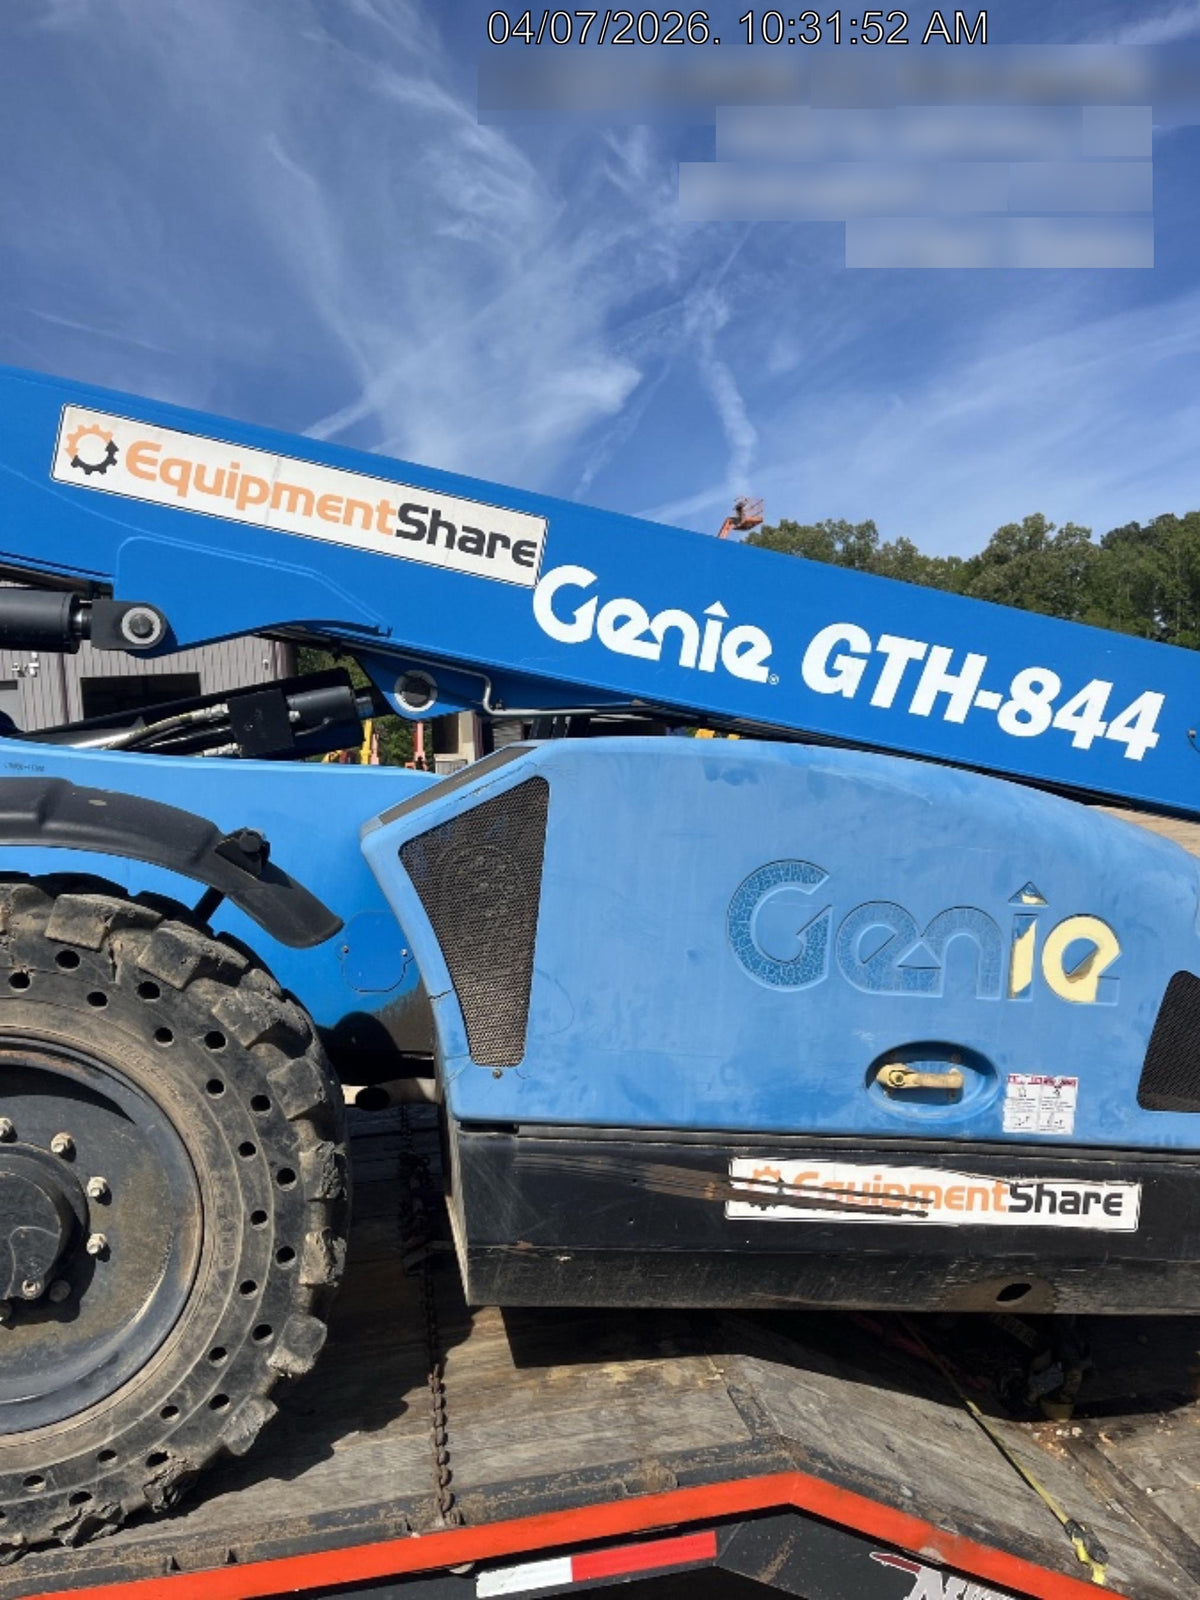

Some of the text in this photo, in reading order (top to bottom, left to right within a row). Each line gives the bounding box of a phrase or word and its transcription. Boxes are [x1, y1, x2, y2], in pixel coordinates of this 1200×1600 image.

[126, 440, 537, 568] EquipmentShare
[533, 565, 1165, 761] Genie GTH-844
[727, 860, 1121, 1005] Genie
